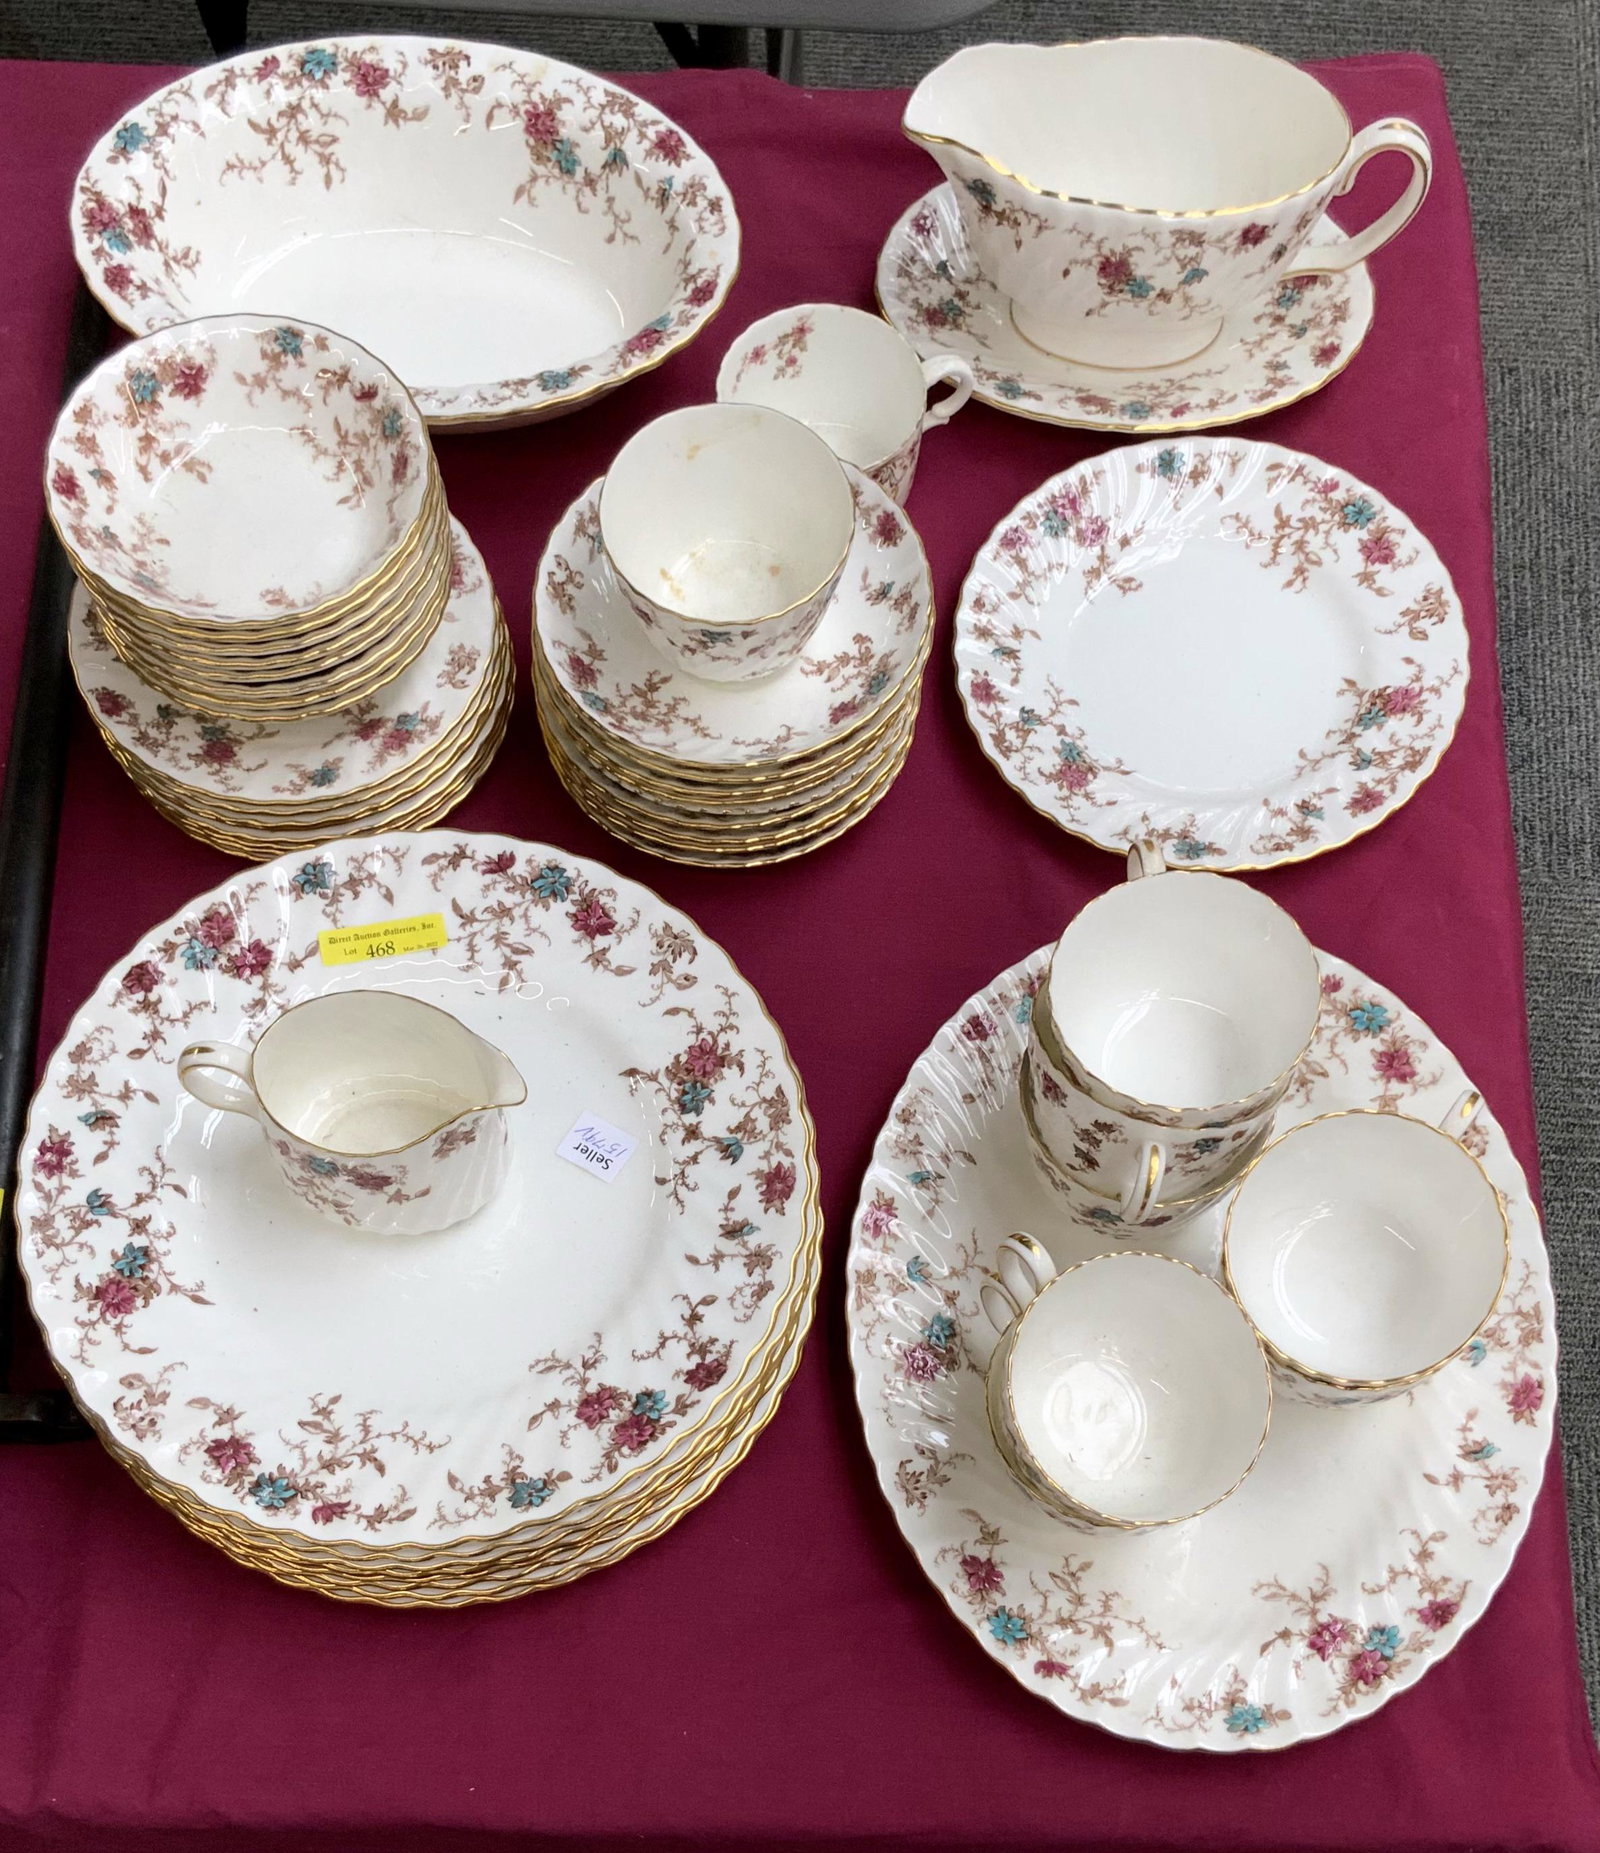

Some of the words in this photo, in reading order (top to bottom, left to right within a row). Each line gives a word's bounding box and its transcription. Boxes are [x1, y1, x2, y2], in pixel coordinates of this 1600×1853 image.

[328, 936, 351, 945] Direct
[354, 932, 381, 941] Auction
[344, 947, 357, 956] Lot
[366, 941, 395, 958] 468
[573, 1142, 614, 1170] Seller
